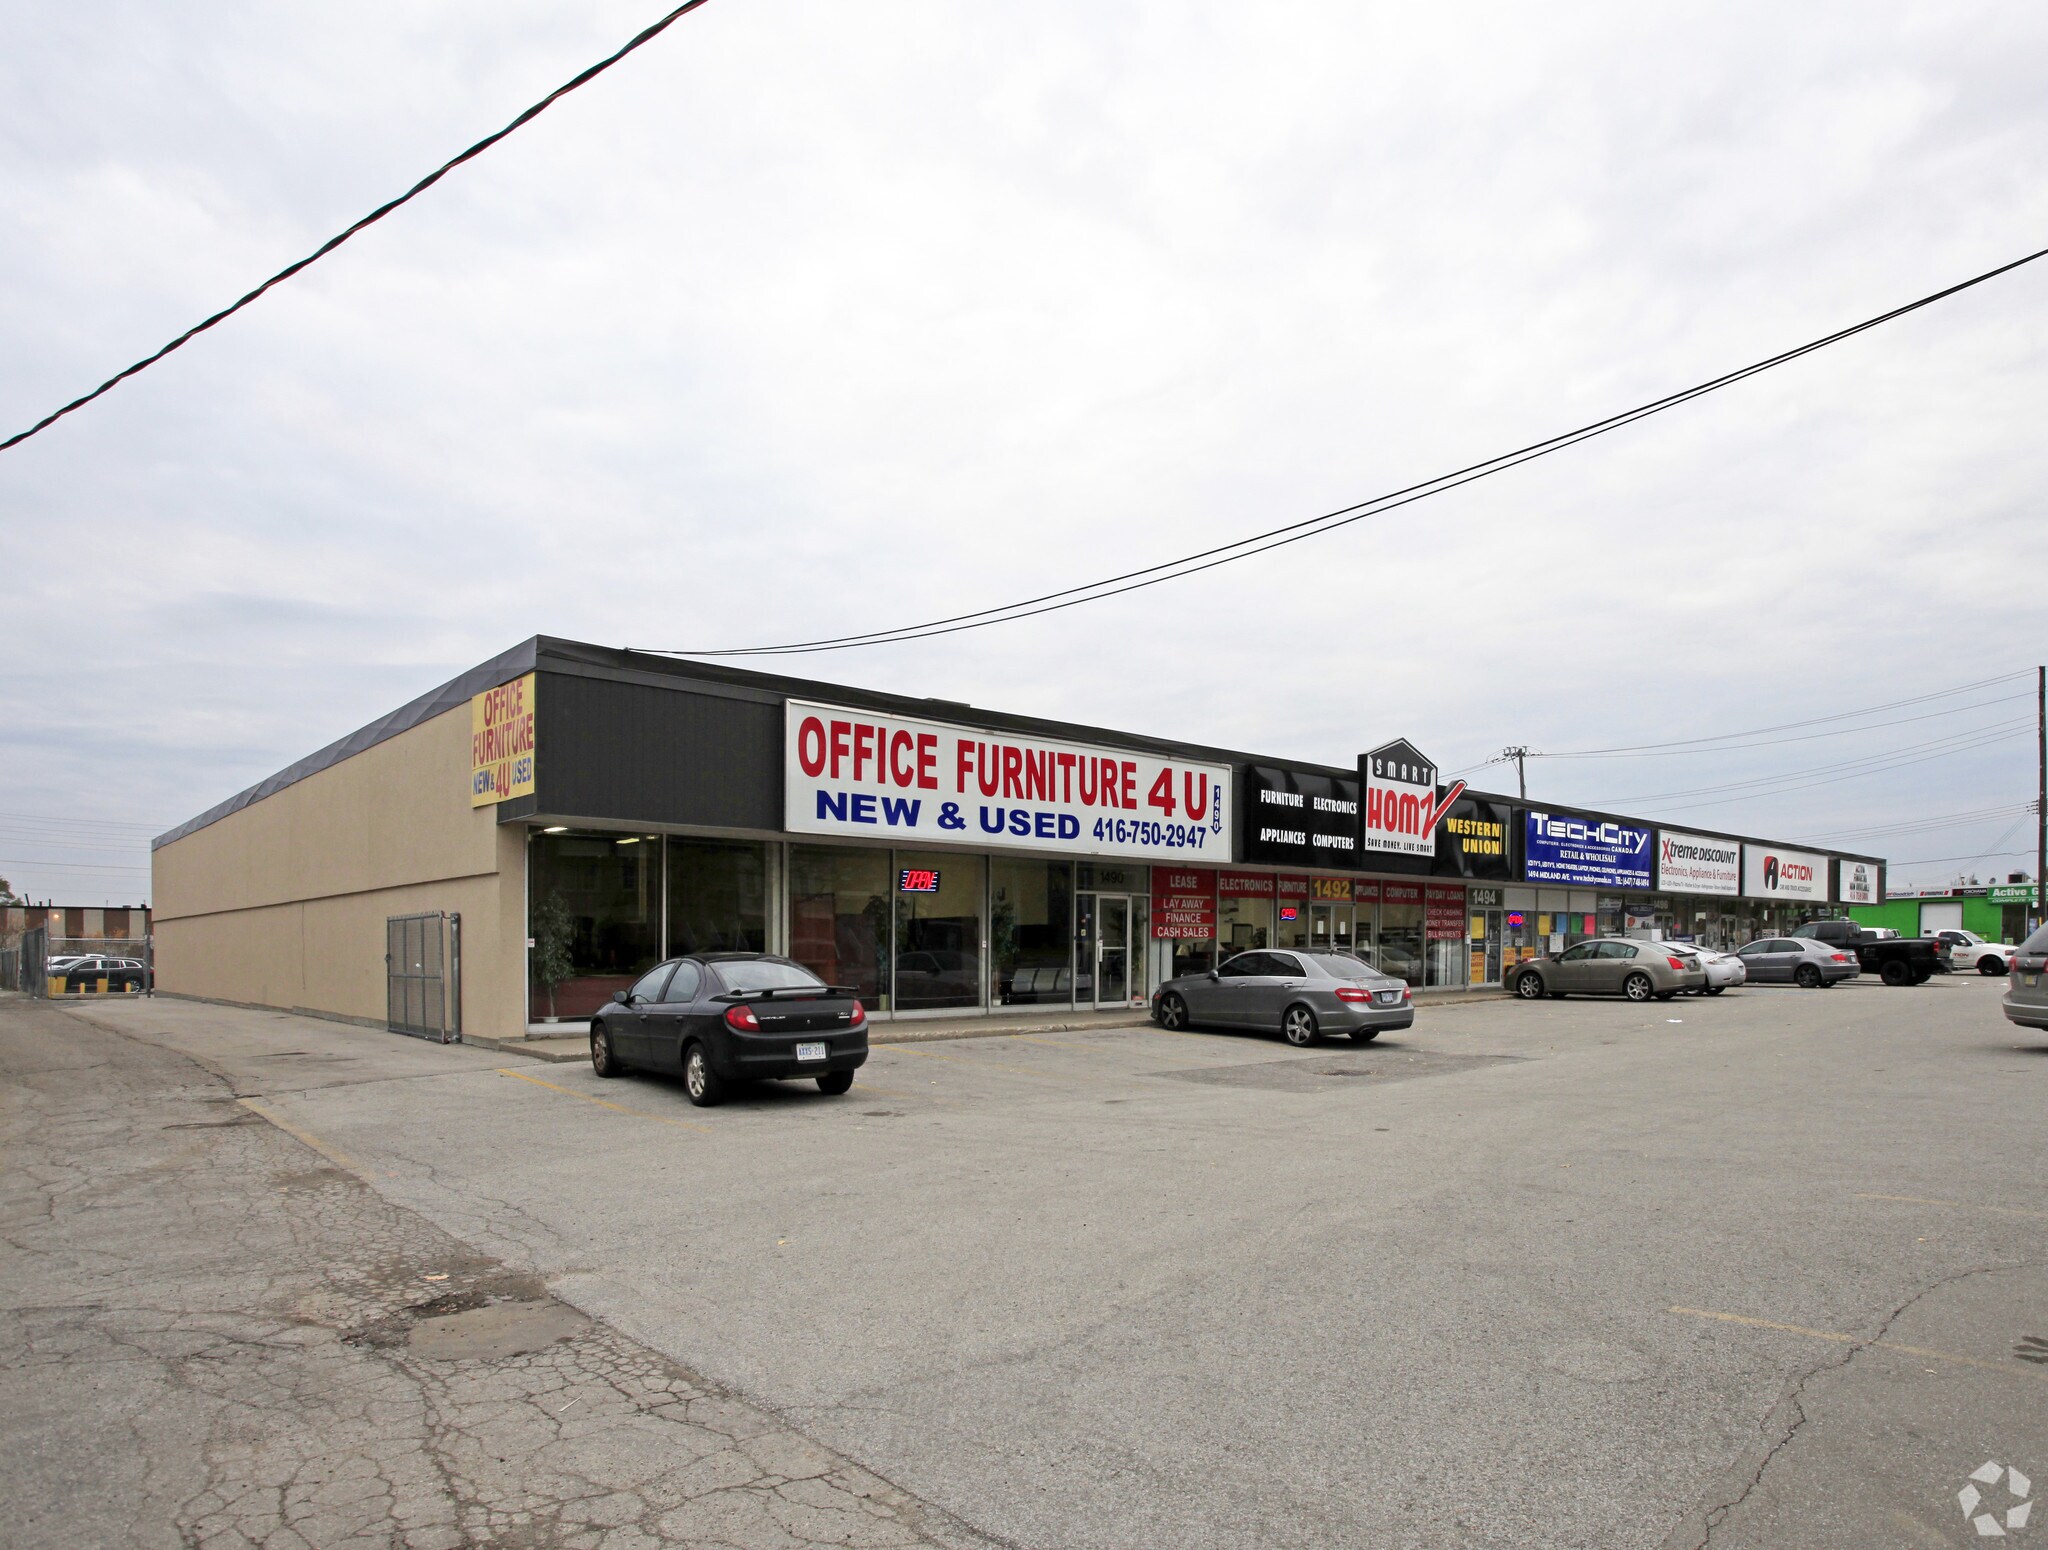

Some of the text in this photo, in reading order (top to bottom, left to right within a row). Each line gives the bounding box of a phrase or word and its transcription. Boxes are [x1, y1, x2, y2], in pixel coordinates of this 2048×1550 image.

[484, 678, 523, 727] OFFICE
[473, 713, 533, 767] FURNITURE
[798, 716, 938, 790] OFFICE
[957, 739, 1137, 810] FURNITURE
[1376, 758, 1428, 784] SMART
[473, 757, 532, 795] NEW & USED
[496, 761, 511, 798] 4U
[1260, 789, 1357, 814] FURNITURE ELECTRONICS
[816, 790, 1206, 848] NEW & USED 416-750-2947
[1447, 818, 1500, 838] WESTERN
[1260, 828, 1354, 850] APPLIANCES COMPUTERS
[1368, 838, 1380, 848] SAVE
[1404, 842, 1414, 851] LIVE
[1416, 844, 1432, 853] SMART
[1462, 838, 1500, 855] UNION
[1560, 850, 1616, 863] RETAIL & WHOLESALE
[1612, 846, 1634, 854] CANADA
[1662, 838, 1736, 864] Xtreme DISCOUNT
[904, 870, 936, 889] OPEN
[1100, 872, 1124, 884] 1490
[1528, 870, 1539, 878] 1494
[1540, 871, 1561, 880] MIDLAND
[1661, 863, 1688, 878] Electronics,
[1689, 866, 1712, 880] Appliance
[1717, 869, 1736, 881] Furniture
[1780, 864, 1812, 881] ACTION
[1170, 876, 1197, 888] LEASE
[1220, 878, 1273, 892] ELECTRONICS
[1279, 881, 1307, 893] FURNITURE
[1314, 880, 1351, 898] 1492
[1386, 887, 1418, 898] COMPUTER
[1426, 888, 1464, 900] PAYDAY LOANS
[1473, 889, 1496, 904] 1494
[1993, 888, 2027, 896] Active
[1163, 898, 1204, 909] LAY AWAY
[1166, 913, 1201, 923] FINANCE
[1427, 908, 1442, 916] CHECK
[1157, 927, 1209, 938] CASH SALES
